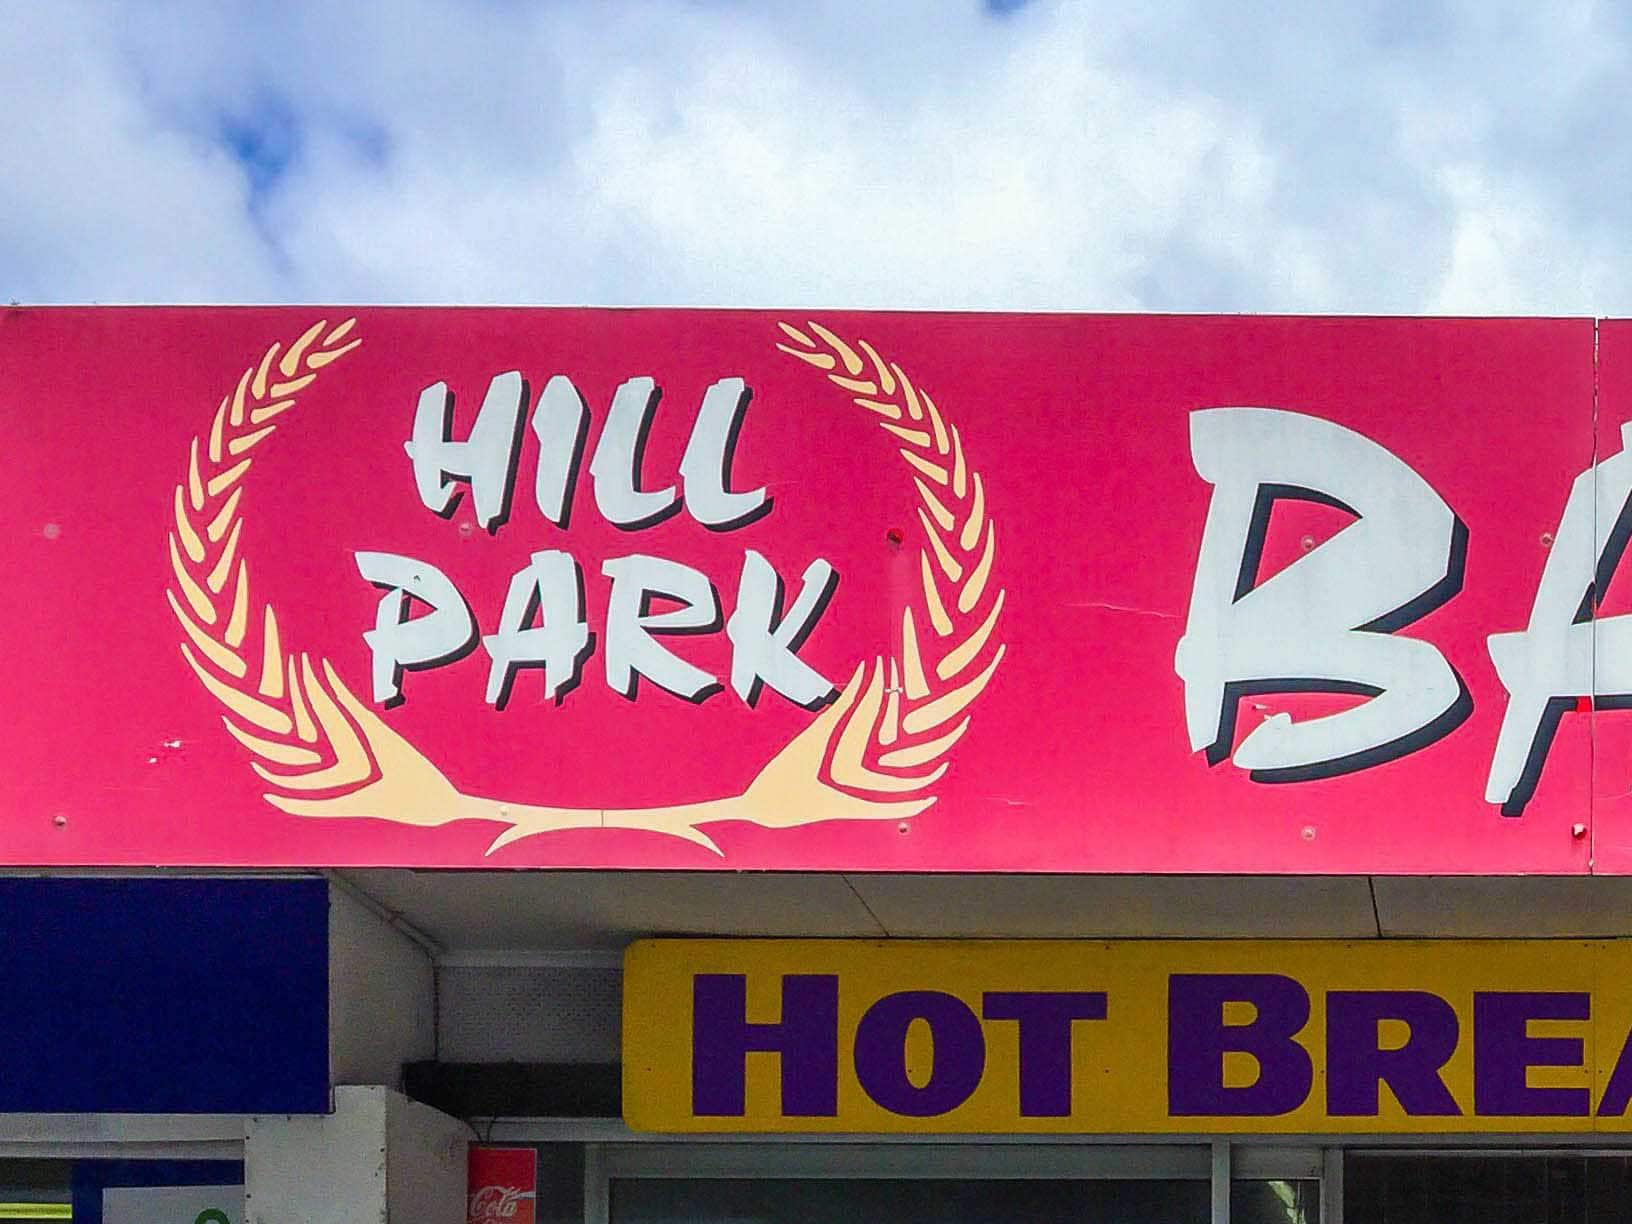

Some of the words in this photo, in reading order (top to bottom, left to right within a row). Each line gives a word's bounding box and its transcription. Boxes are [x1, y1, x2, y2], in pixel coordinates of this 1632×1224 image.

[404, 370, 773, 532] HILL
[356, 550, 839, 710] PARK
[693, 975, 1106, 1118] HOT
